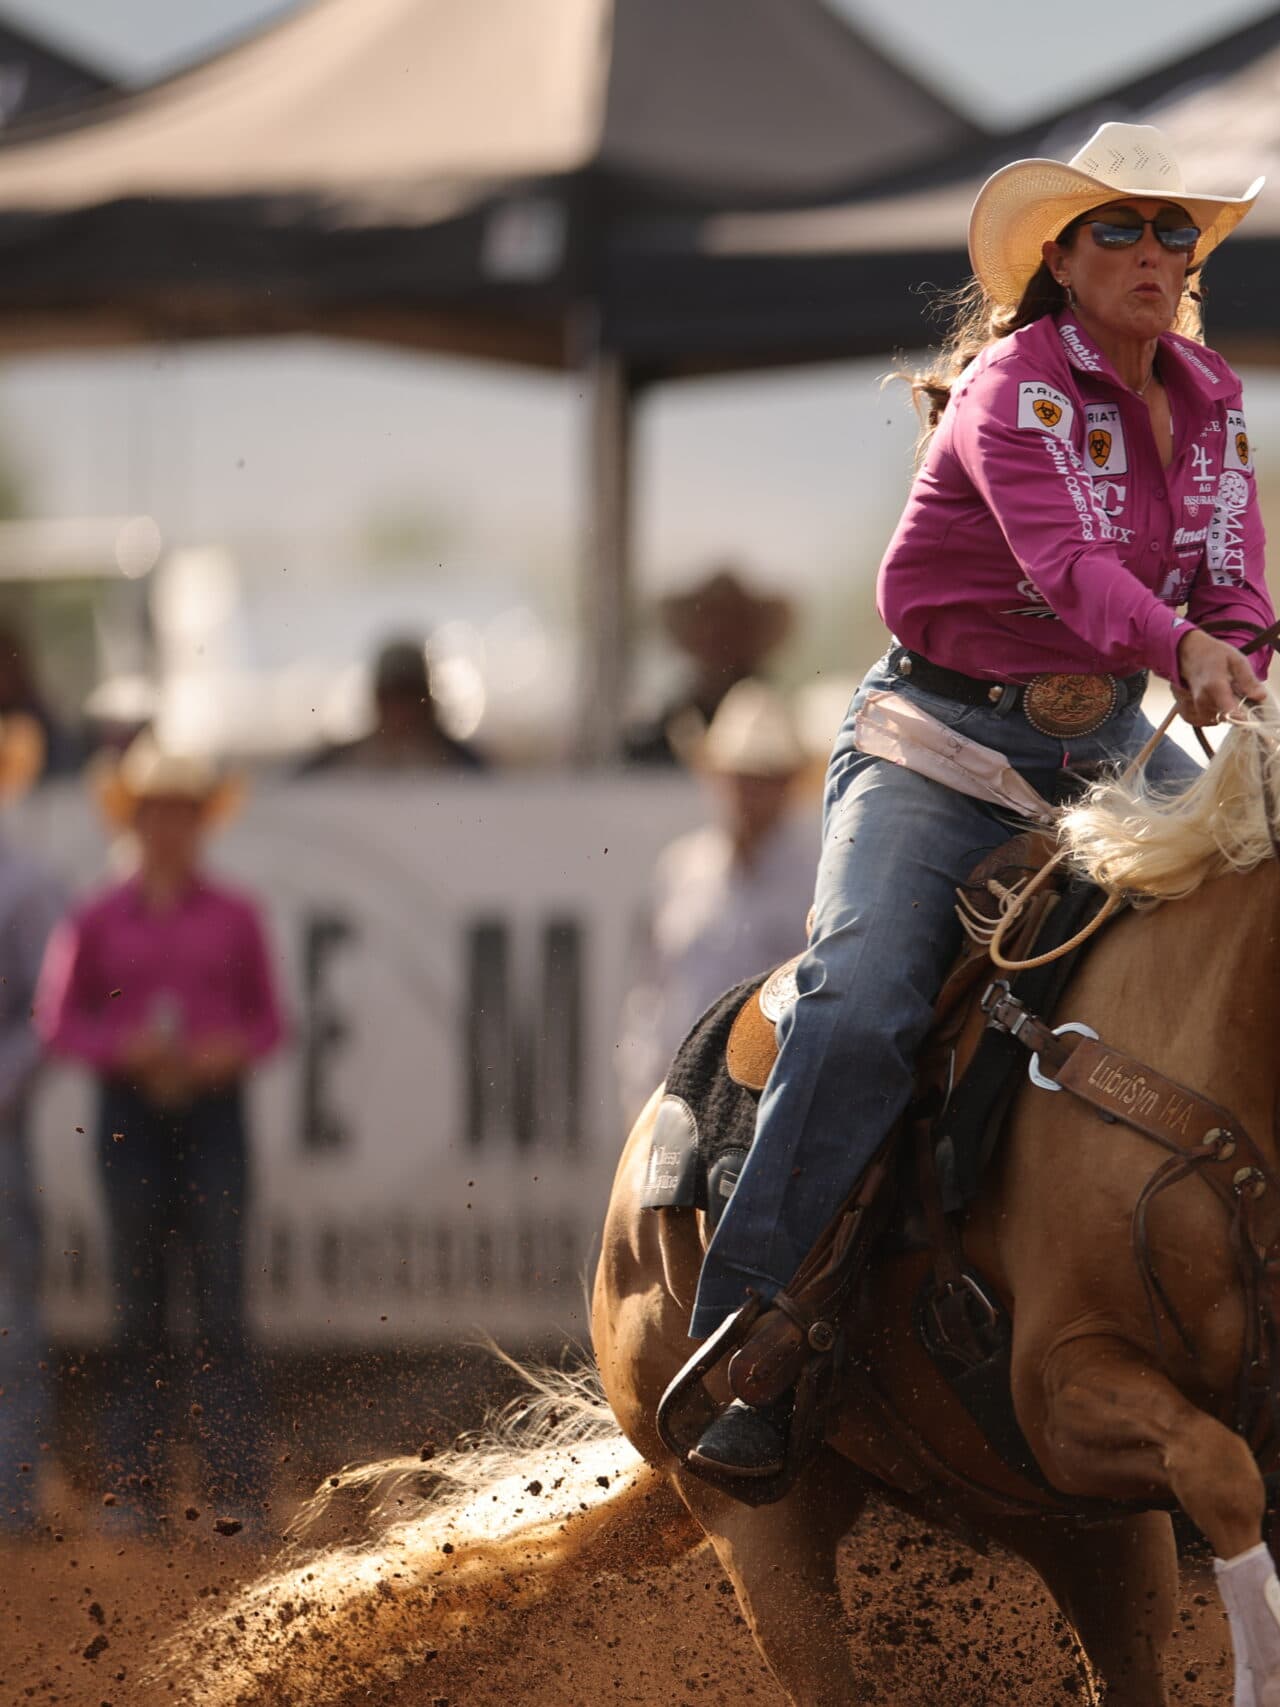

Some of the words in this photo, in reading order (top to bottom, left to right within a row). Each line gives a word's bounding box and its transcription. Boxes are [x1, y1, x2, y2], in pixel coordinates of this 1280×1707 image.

[1023, 387, 1069, 406] ARIAT
[1087, 411, 1118, 424] RIAT
[1222, 506, 1247, 588] MART
[1087, 1055, 1160, 1116] LubriSyn
[1158, 1094, 1195, 1135] HA
